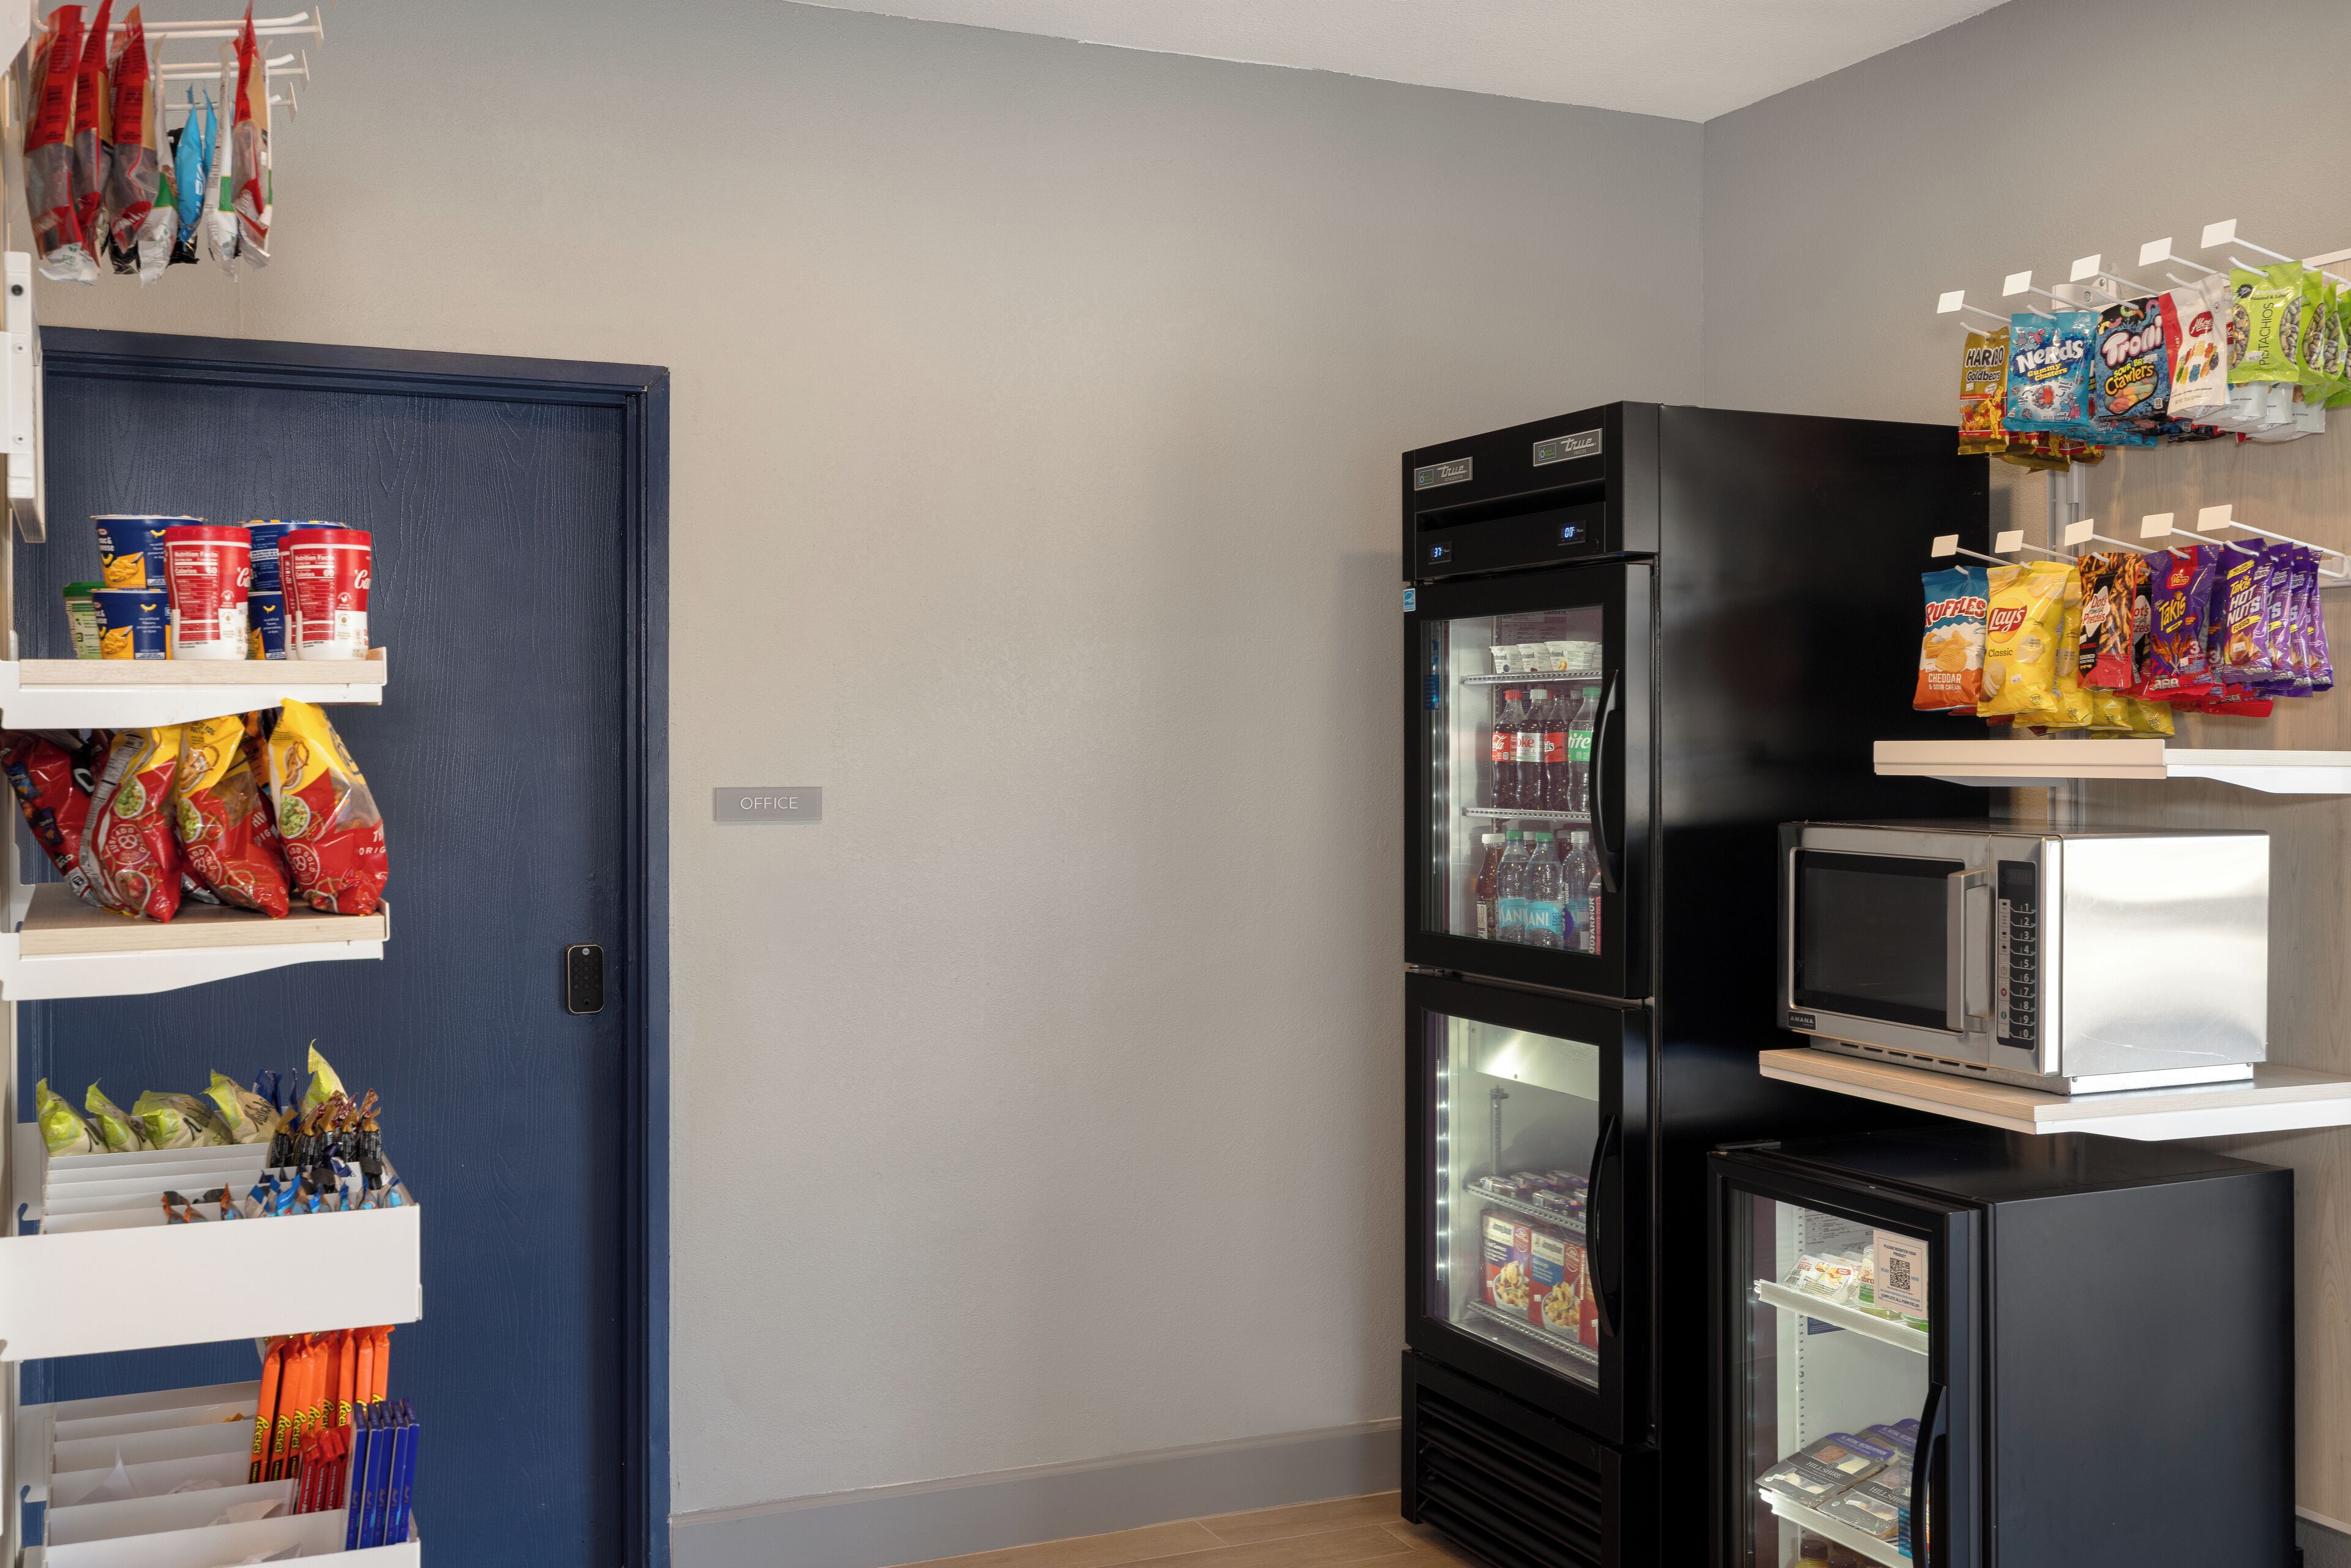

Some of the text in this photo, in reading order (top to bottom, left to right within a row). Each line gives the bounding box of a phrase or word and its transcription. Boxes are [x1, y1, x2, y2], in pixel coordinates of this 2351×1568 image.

[2258, 302, 2274, 366] PISTACHIOS
[2102, 315, 2164, 367] Trolli
[1965, 345, 2005, 368] HARIBO
[1966, 370, 2001, 383] Goldbears
[2027, 362, 2062, 378] Gummy
[2113, 362, 2132, 378] SOUR
[2105, 364, 2155, 396] Crawlers
[2230, 578, 2252, 598] Takis
[2230, 585, 2257, 612] HOT
[1924, 596, 1987, 628] RUFFLES
[2134, 604, 2149, 617] ot's
[2159, 596, 2186, 631] Takis
[2227, 596, 2262, 627] NUTS
[1989, 607, 2025, 633] Lay's
[2083, 613, 2106, 625] Pretzels
[1988, 648, 2013, 658] Classic
[2189, 640, 2200, 654] 3
[1928, 673, 1962, 684] CHEDDAR
[740, 797, 798, 810] OFFICE
[2024, 903, 2030, 912] 1
[2024, 917, 2030, 926] 2
[2024, 931, 2030, 940] 3
[2024, 945, 2030, 954] 4
[2023, 959, 2029, 968] 5
[2023, 973, 2029, 982] 6
[2023, 988, 2029, 996] 7
[2023, 1001, 2029, 1010] 8
[1790, 1016, 1814, 1024] AMANA
[2023, 1015, 2029, 1024] 9
[2023, 1029, 2029, 1038] 0
[1806, 1461, 1844, 1479] HILLSHIRE
